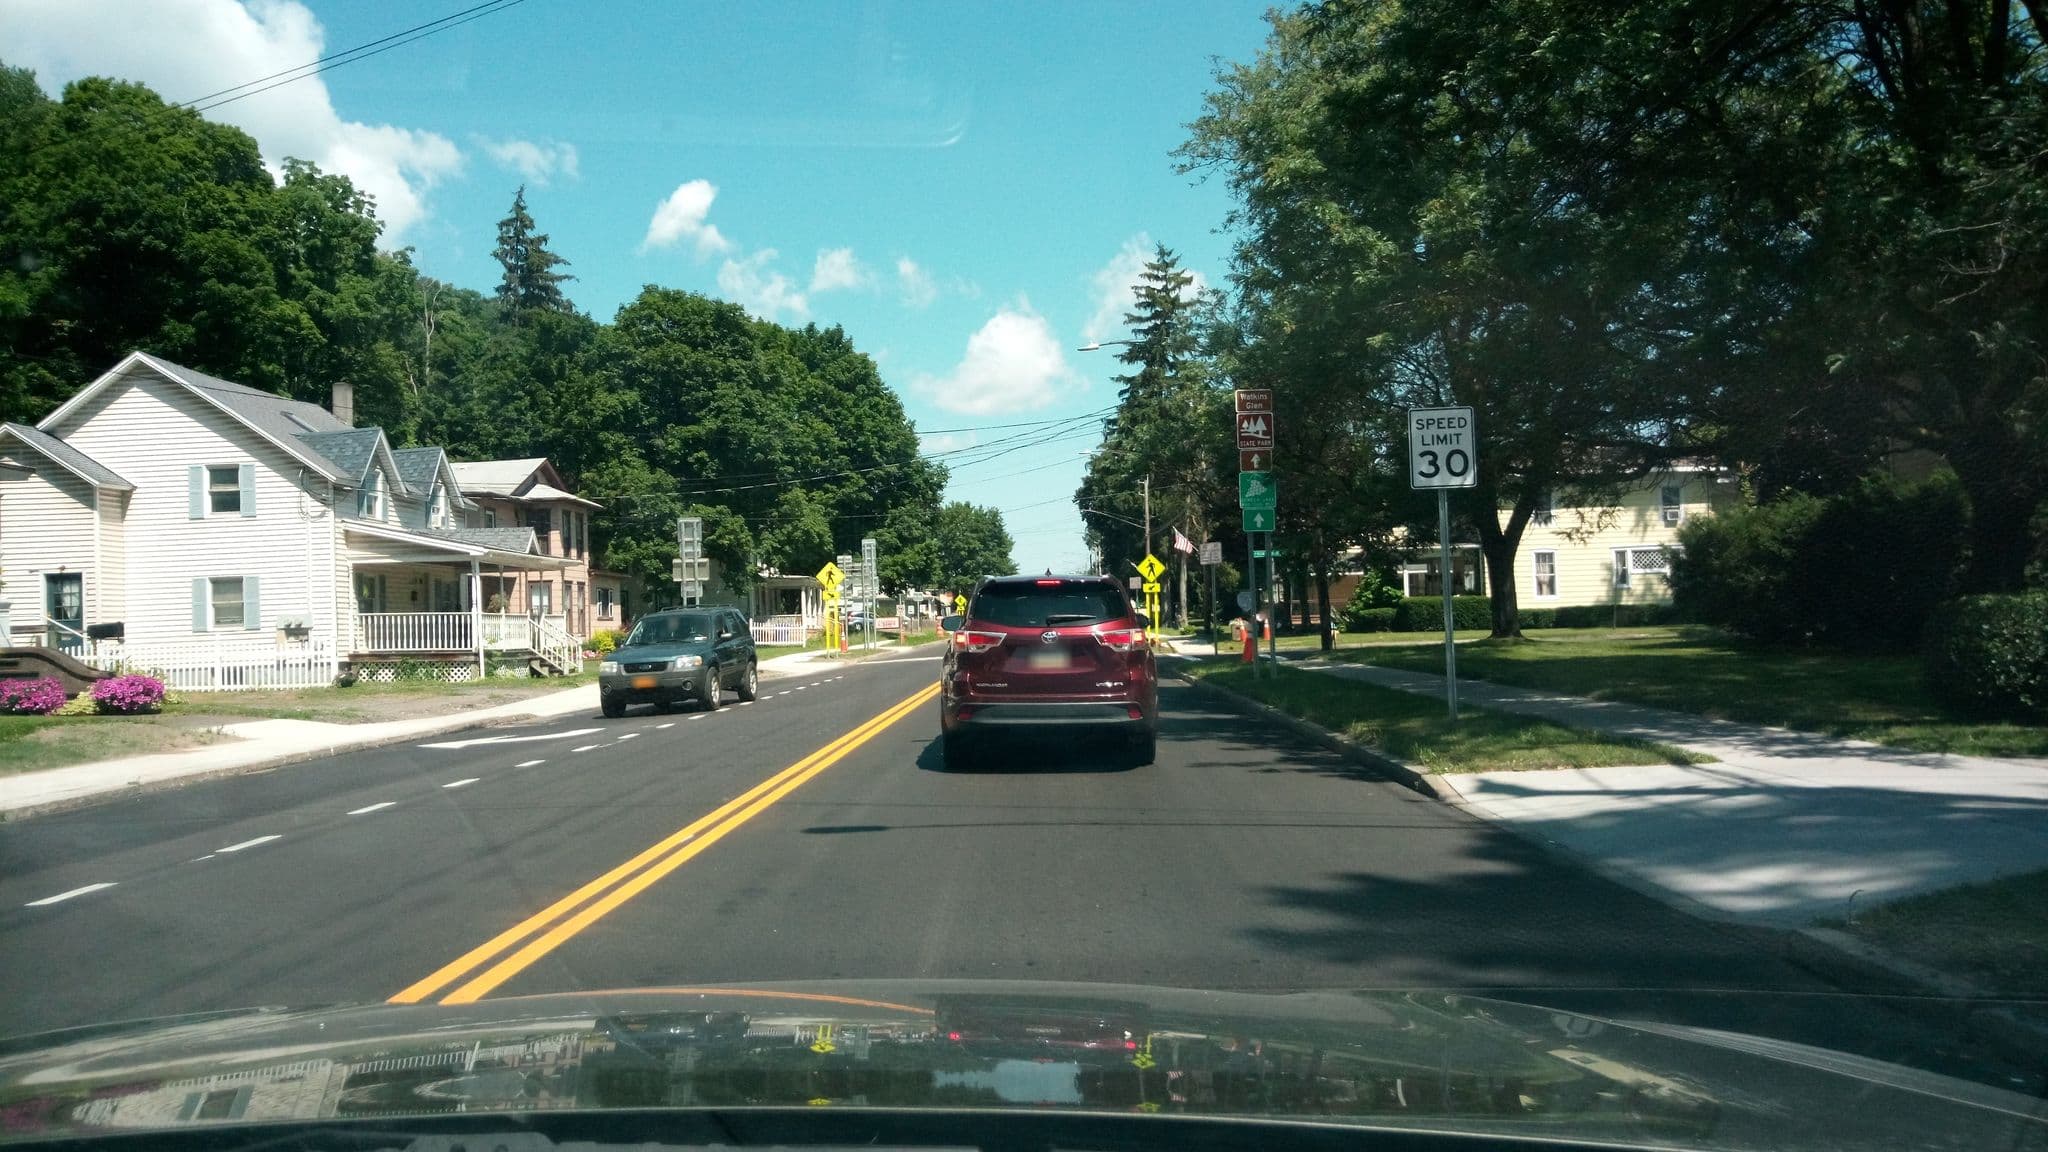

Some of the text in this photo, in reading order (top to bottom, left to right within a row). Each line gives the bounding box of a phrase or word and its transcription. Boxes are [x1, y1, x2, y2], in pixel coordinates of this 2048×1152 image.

[1415, 417, 1467, 430] SPEED
[1421, 433, 1462, 446] LIMIT
[1418, 449, 1469, 478] 30
